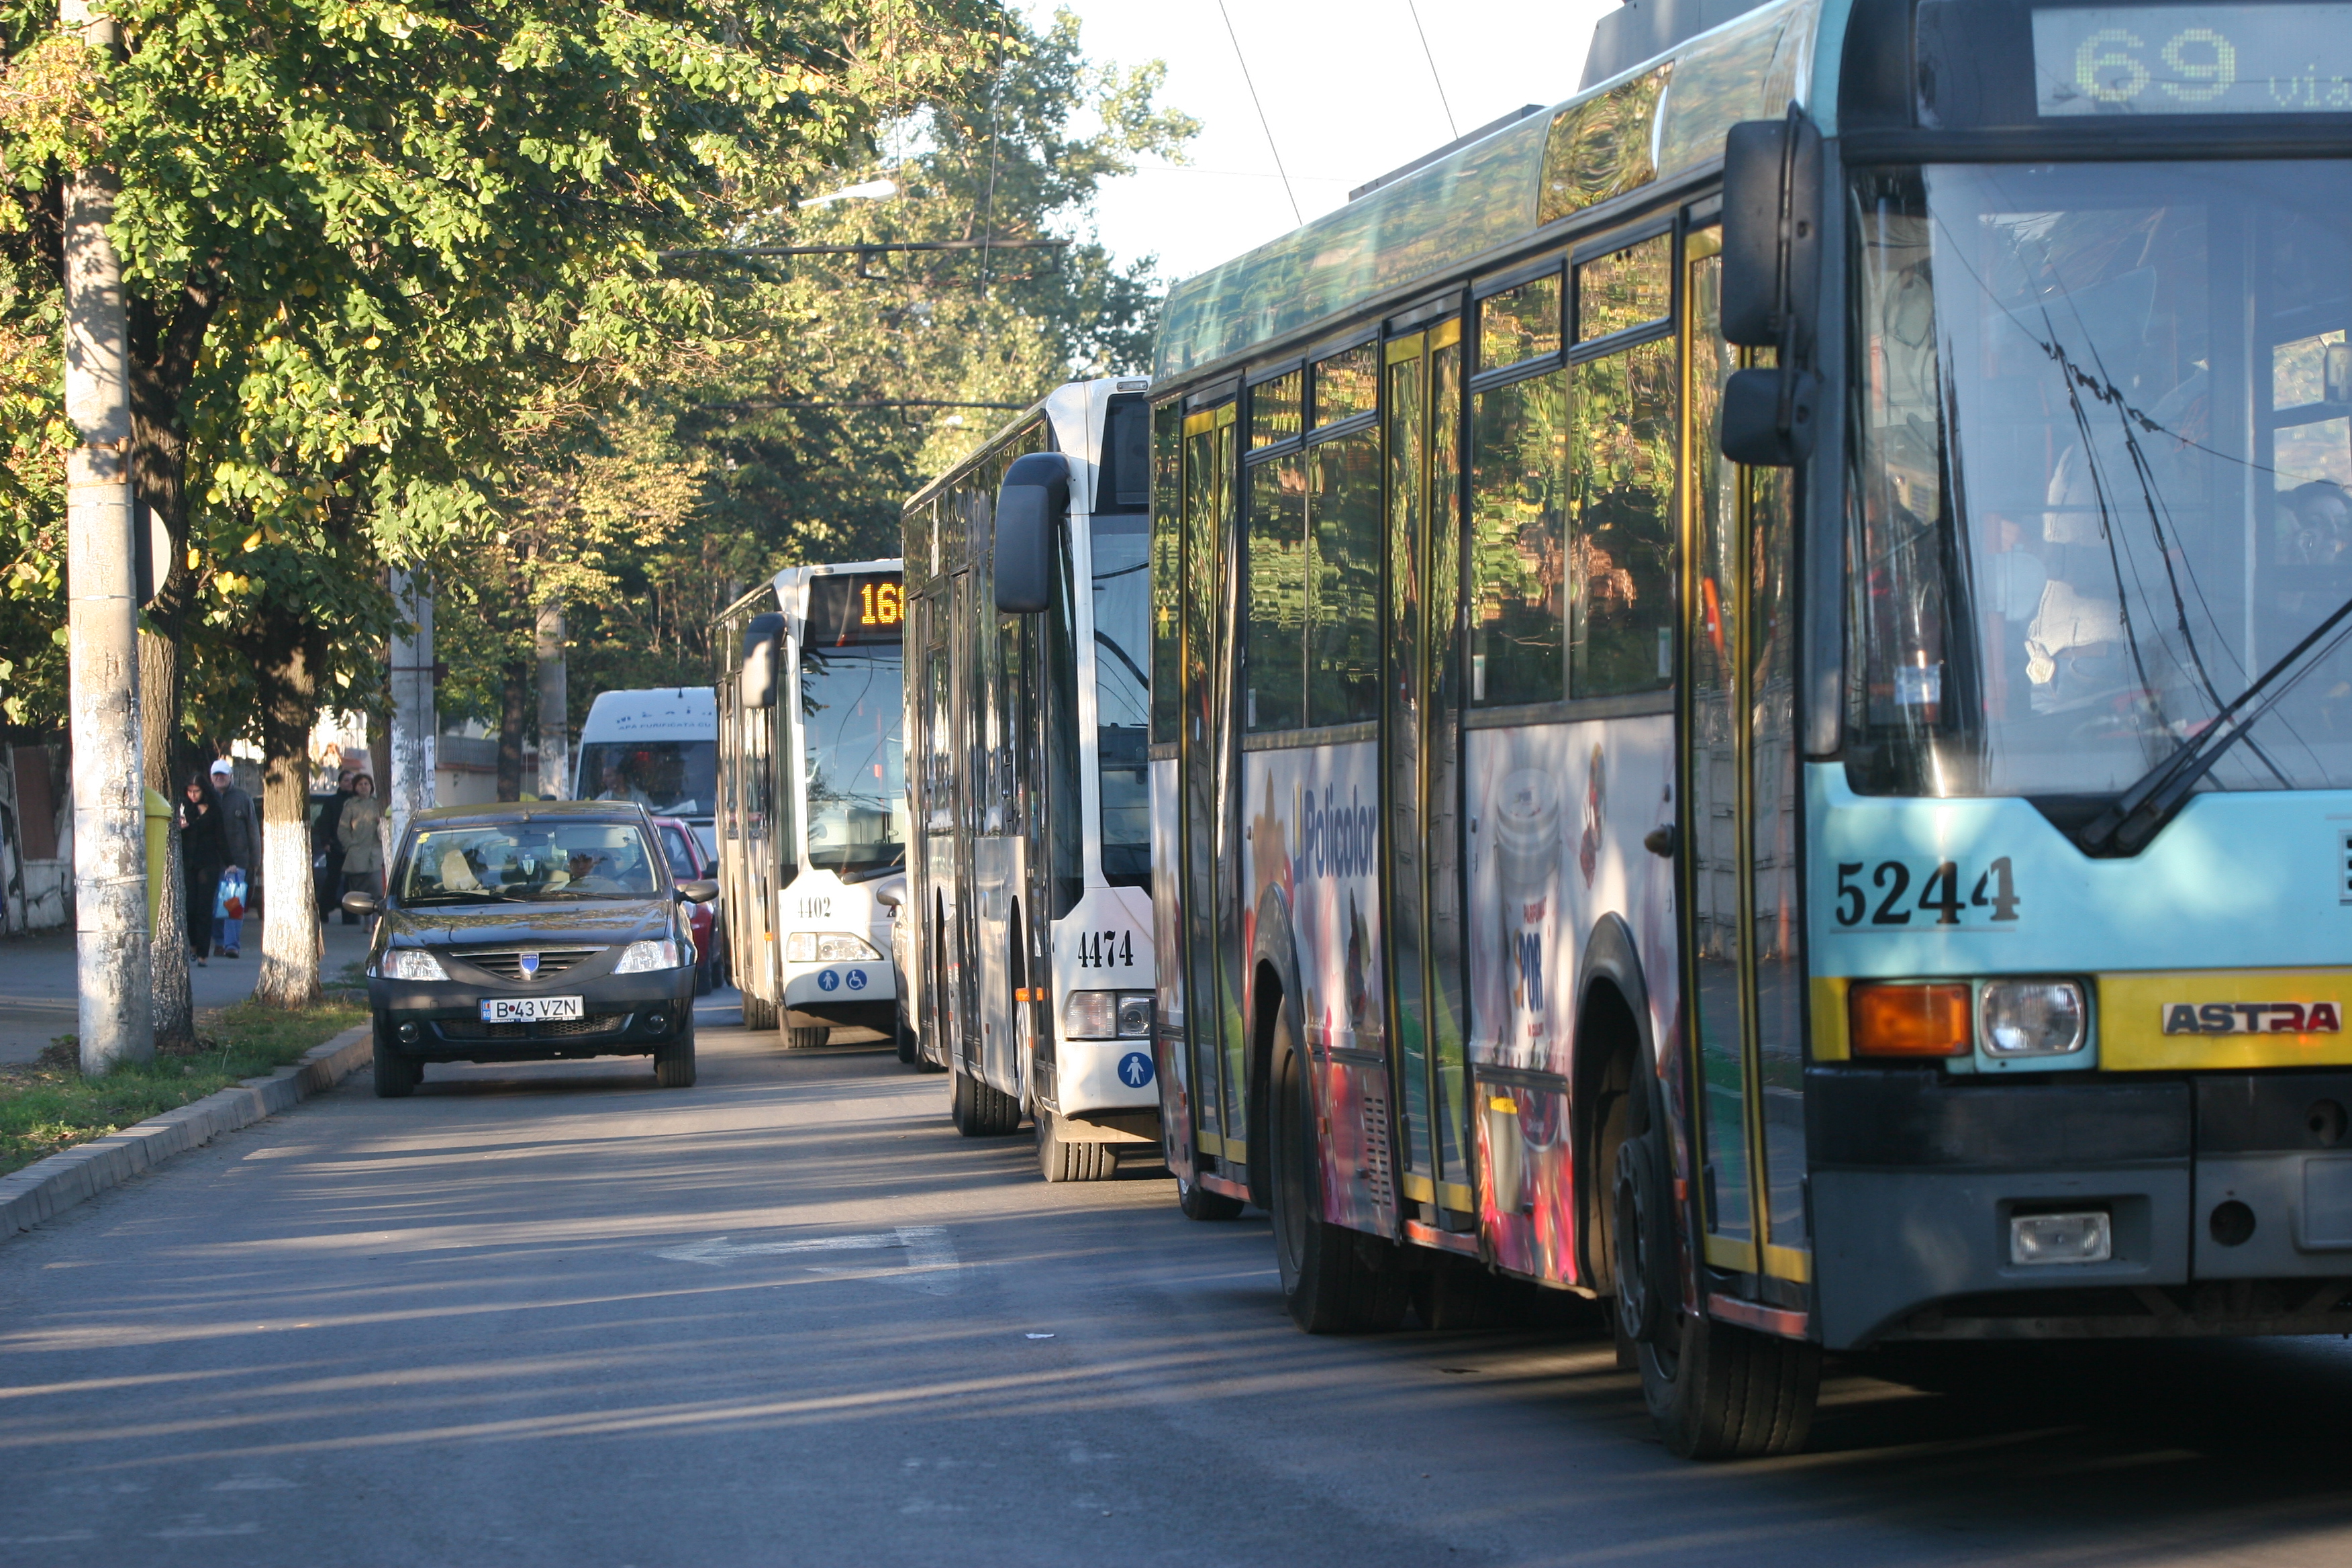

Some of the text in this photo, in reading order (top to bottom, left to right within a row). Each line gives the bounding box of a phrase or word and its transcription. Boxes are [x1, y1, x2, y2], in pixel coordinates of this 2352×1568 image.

[2076, 29, 2236, 102] 69
[1305, 781, 1376, 879] Policolor
[797, 896, 832, 918] 4402
[1836, 856, 2020, 926] 5244
[1077, 930, 1134, 967] 4474
[497, 999, 576, 1018] B 43 VZN
[2166, 1003, 2340, 1032] ASTRA
